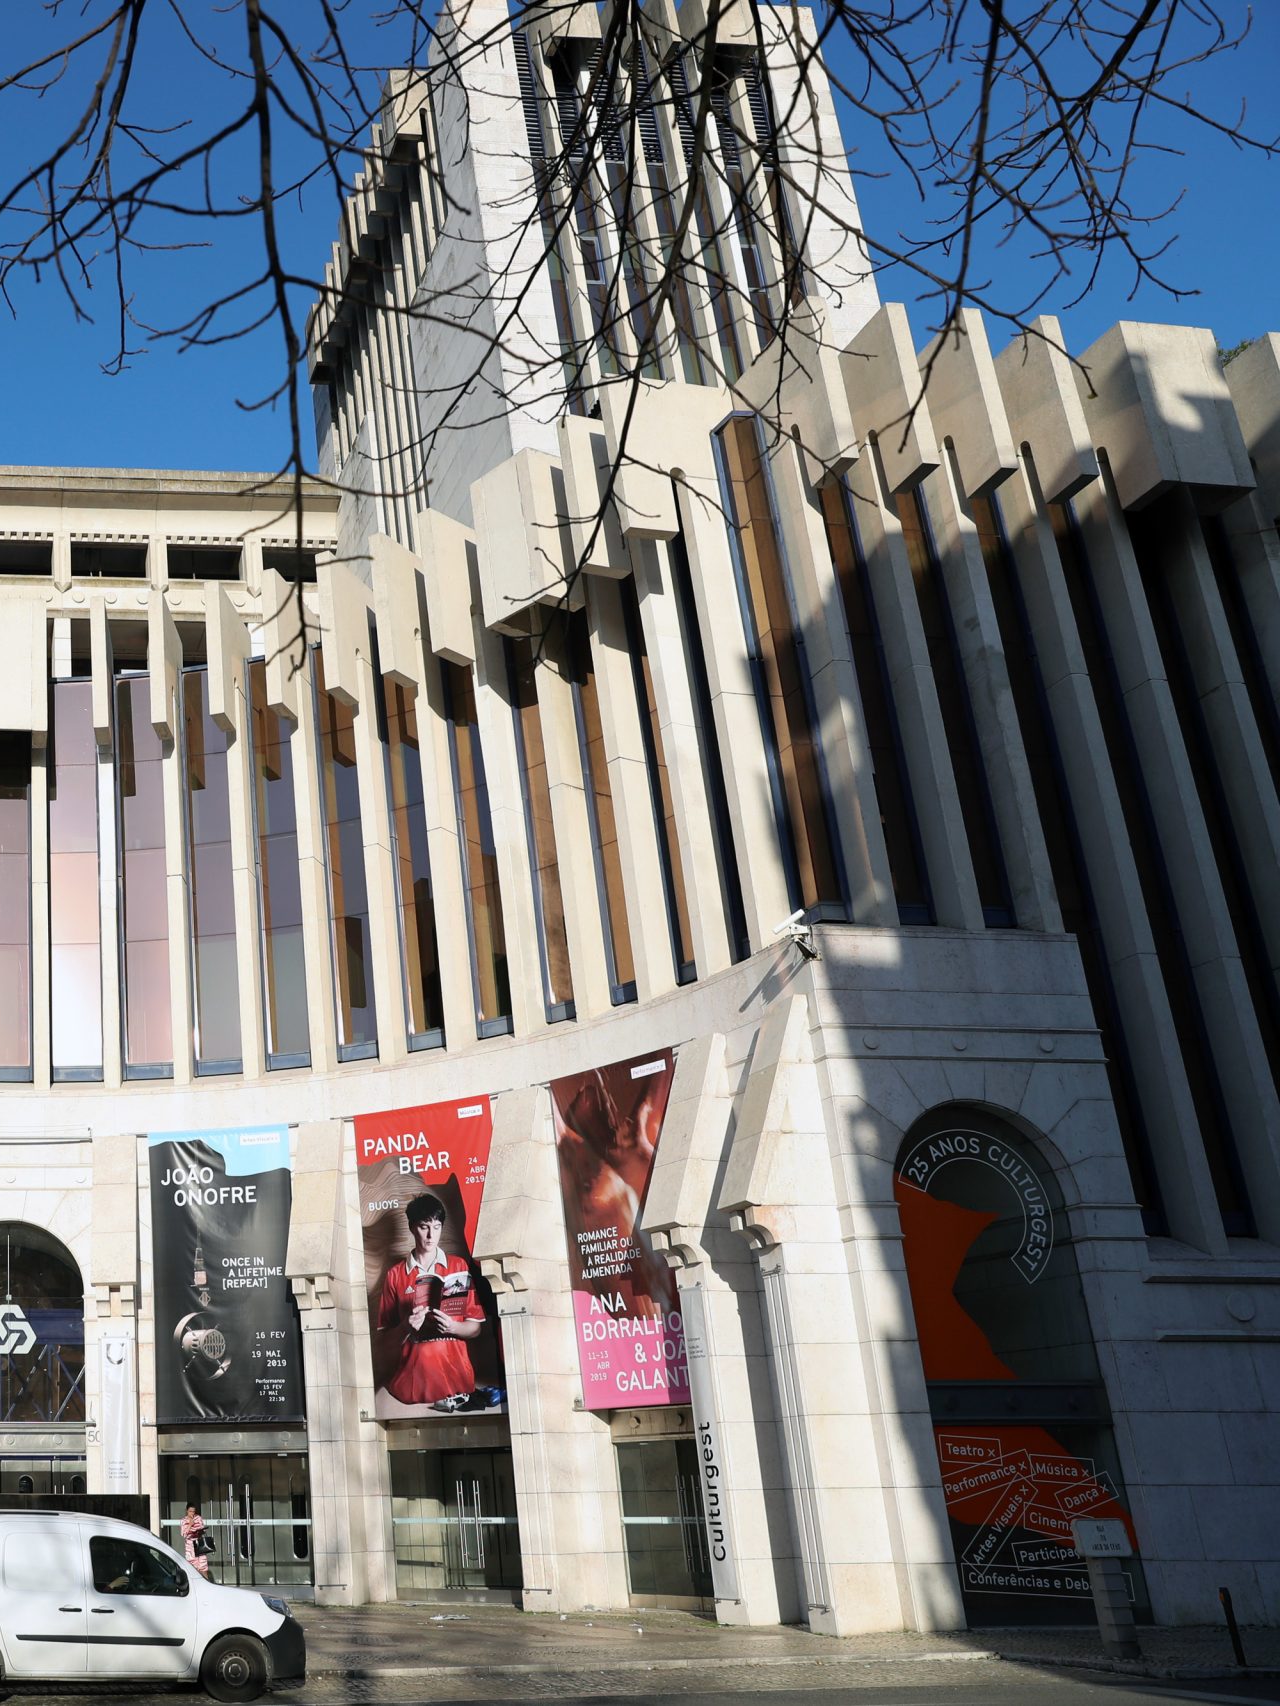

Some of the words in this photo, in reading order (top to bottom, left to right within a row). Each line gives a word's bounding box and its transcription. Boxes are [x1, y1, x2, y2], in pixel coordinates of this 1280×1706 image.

[363, 1131, 429, 1157] PANDA
[399, 1151, 450, 1175] BEAR
[468, 1157, 478, 1165] 24
[160, 1164, 214, 1186] JOÃO
[465, 1175, 485, 1184] 2019
[173, 1185, 257, 1207] ONOFRE
[908, 1156, 929, 1183] 25
[928, 1136, 980, 1162] ANOS
[988, 1145, 1047, 1272] CULTURGEST
[368, 1200, 399, 1211] BUOYS
[577, 1226, 618, 1243] ROMANCE
[581, 1239, 618, 1255] FAMILIAR
[620, 1237, 633, 1248] OU
[222, 1257, 250, 1267] ONCE
[253, 1256, 264, 1266] IN
[587, 1256, 594, 1266] A
[594, 1248, 641, 1265] REALIDADE
[228, 1268, 236, 1277] A
[238, 1266, 283, 1277] LIFETIME
[581, 1262, 633, 1280] AUMENTADA
[222, 1276, 268, 1290] [REPEAT]
[590, 1291, 627, 1315] ANA
[256, 1331, 266, 1339] 16
[270, 1331, 286, 1339] FEV
[582, 1311, 682, 1342] BORRALHO
[252, 1350, 262, 1358] 19
[635, 1342, 648, 1363] &
[652, 1334, 687, 1362] JOÃ
[267, 1359, 287, 1367] 2019
[597, 1361, 610, 1370] ABR
[616, 1365, 689, 1392] GALANT
[945, 1442, 984, 1457] Teatro
[1035, 1462, 1078, 1477] Música
[944, 1464, 1017, 1496] Performance
[698, 1420, 726, 1562] Culturgest
[1064, 1488, 1099, 1509] Dança
[973, 1533, 998, 1564] Artes
[991, 1494, 1023, 1533] Visuais
[968, 1572, 1050, 1588] Conferências
[1054, 1579, 1061, 1589] e
[1065, 1577, 1092, 1591] Deb
